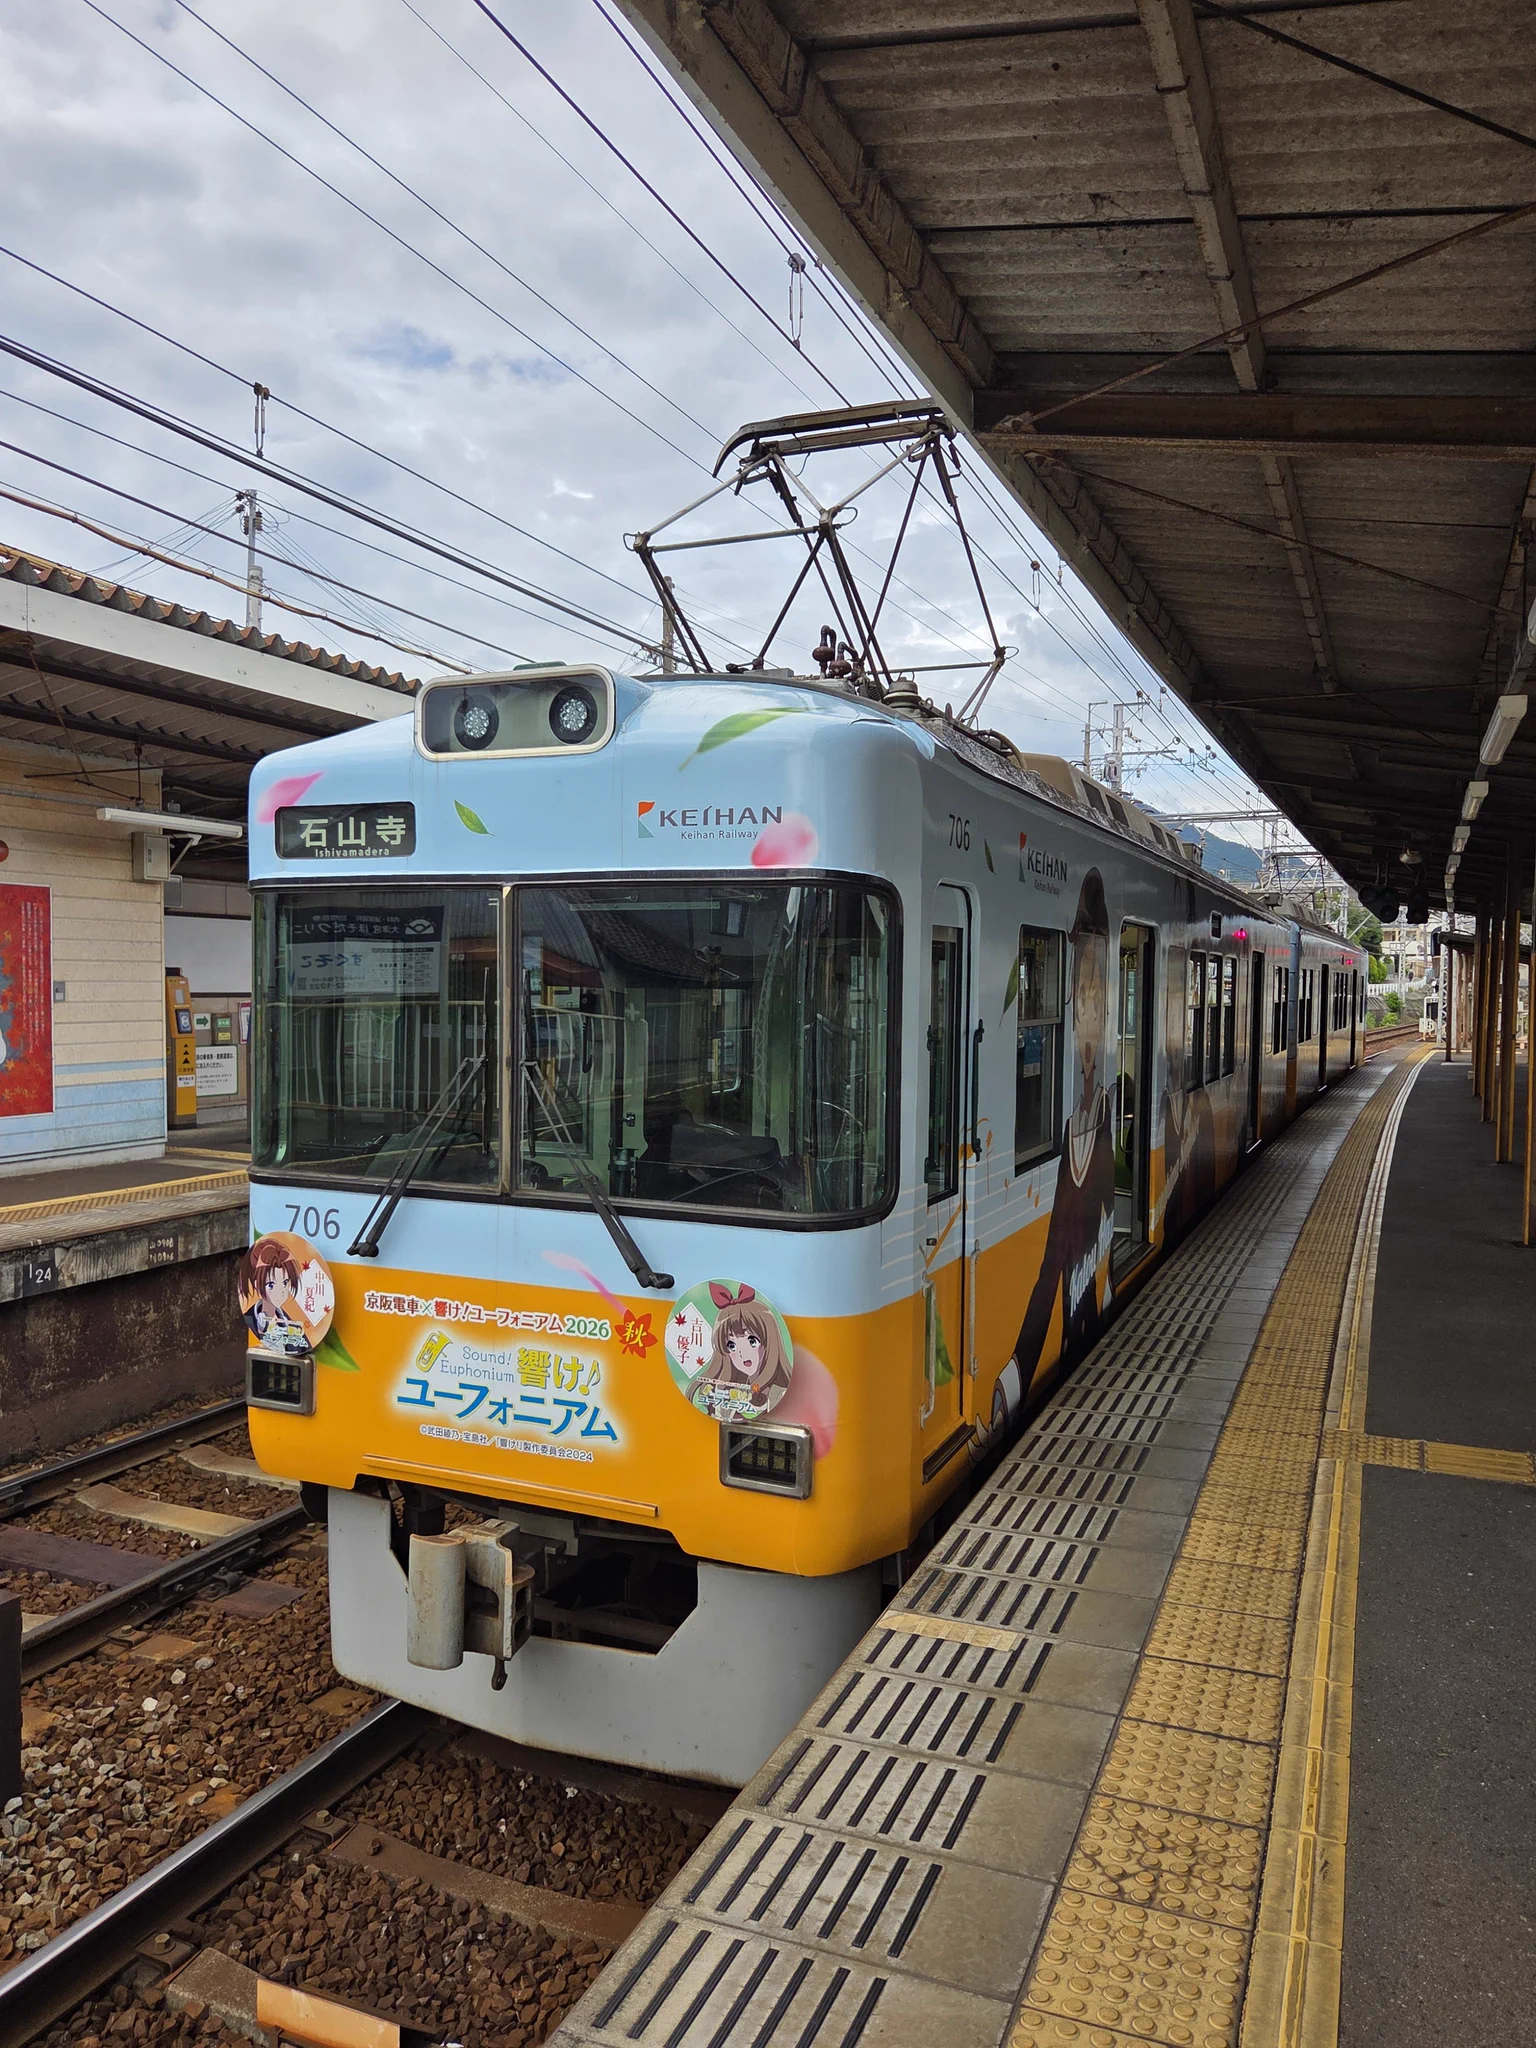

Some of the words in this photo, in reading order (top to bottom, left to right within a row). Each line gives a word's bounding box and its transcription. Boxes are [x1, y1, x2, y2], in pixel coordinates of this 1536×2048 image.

[660, 805, 782, 827] KEIHAN
[299, 815, 406, 848] 石山寺
[681, 831, 715, 840] Keihan
[718, 830, 759, 840] Railway
[948, 813, 970, 851] 706
[315, 847, 390, 858] Ishiyamadera
[1027, 848, 1068, 882] KEIHAN
[285, 1203, 341, 1240] 706
[315, 1270, 325, 1297] 中川
[690, 1317, 703, 1347] 吉川
[462, 1346, 512, 1366] Sound!
[677, 1335, 690, 1364] 優子
[440, 1360, 515, 1384] Euphonium
[397, 1377, 619, 1442] ユーフォニアム
